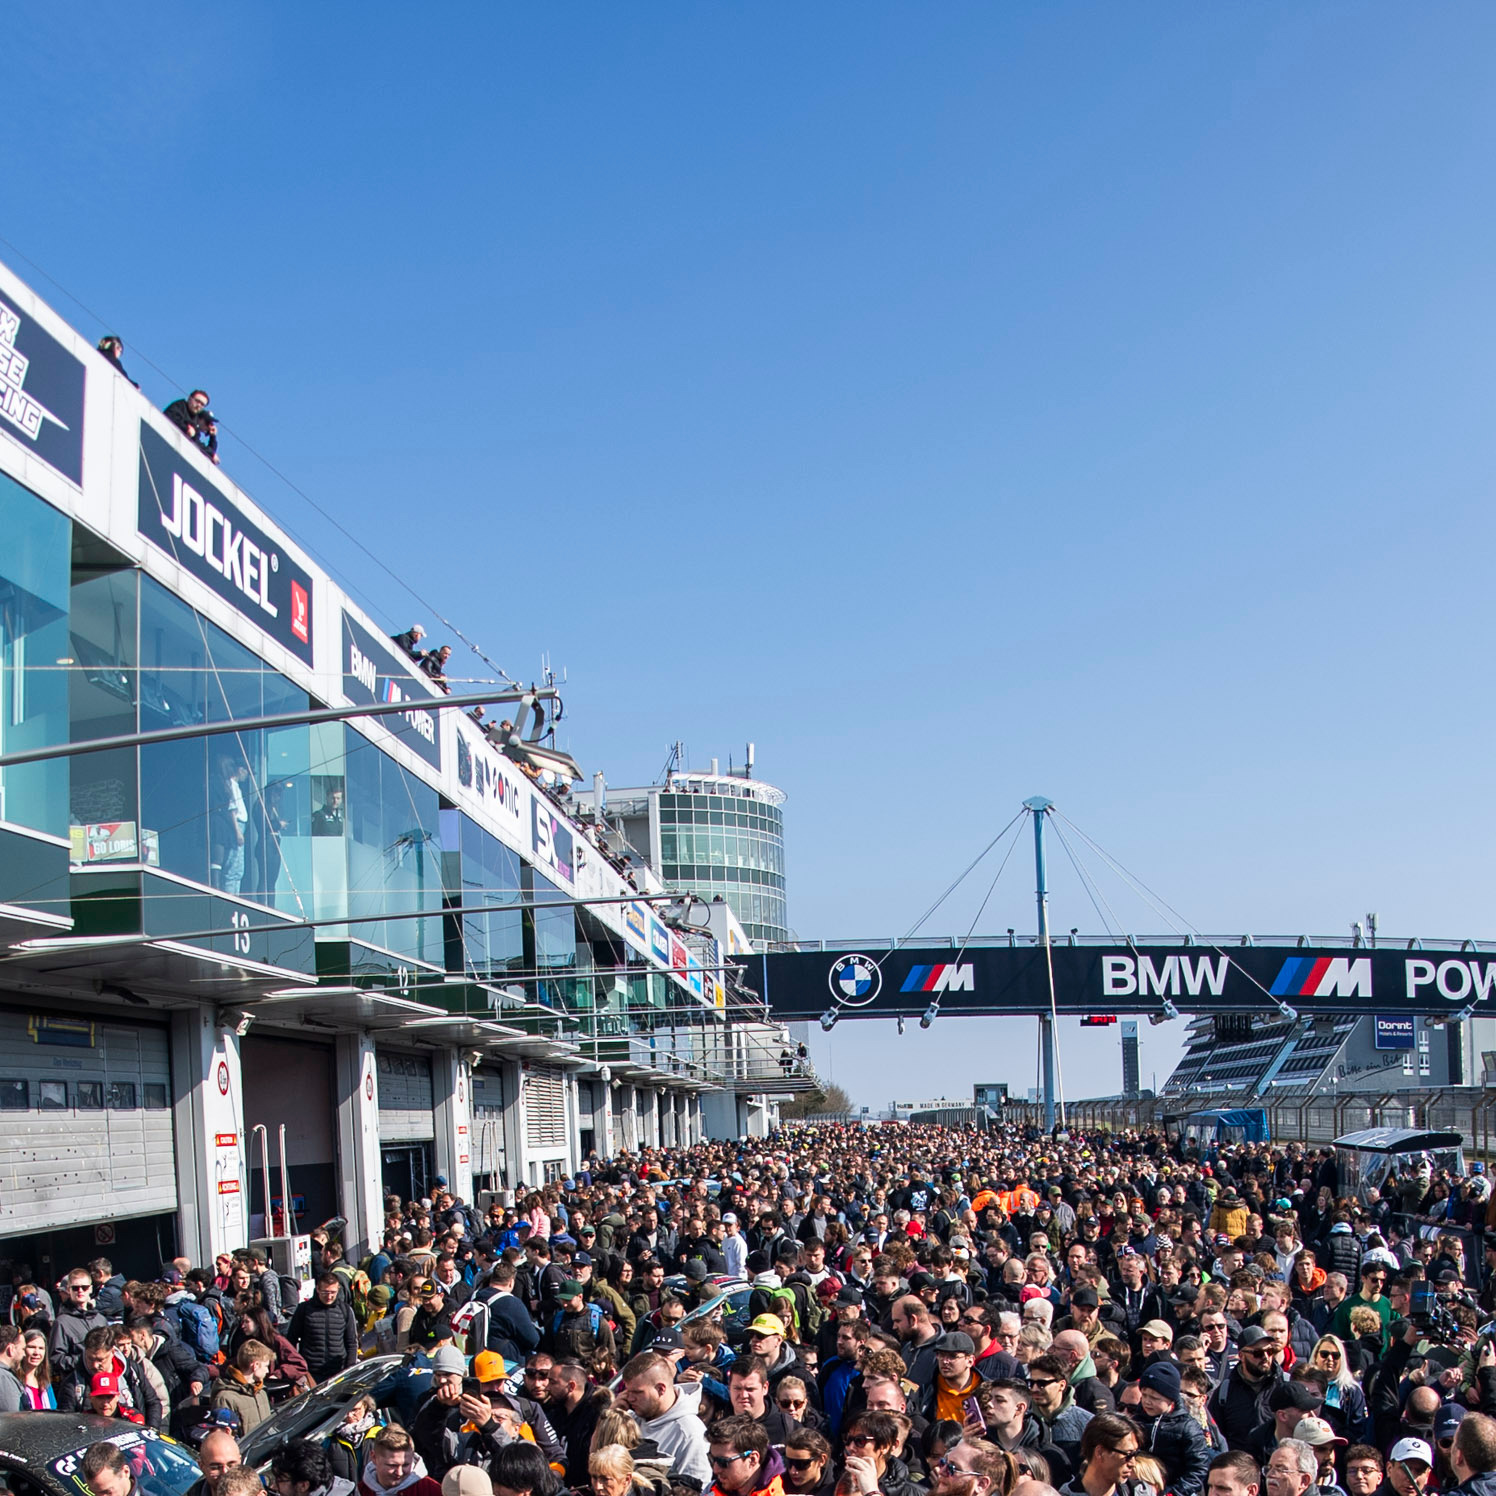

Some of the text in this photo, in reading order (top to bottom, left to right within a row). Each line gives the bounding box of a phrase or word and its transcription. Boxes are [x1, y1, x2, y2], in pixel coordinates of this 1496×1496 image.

[351, 644, 377, 693] BMW
[405, 694, 435, 745] POWER
[231, 911, 251, 954] 13
[397, 965, 409, 996] 12
[1101, 955, 1230, 996] BMW
[1378, 1020, 1413, 1030] Dorint
